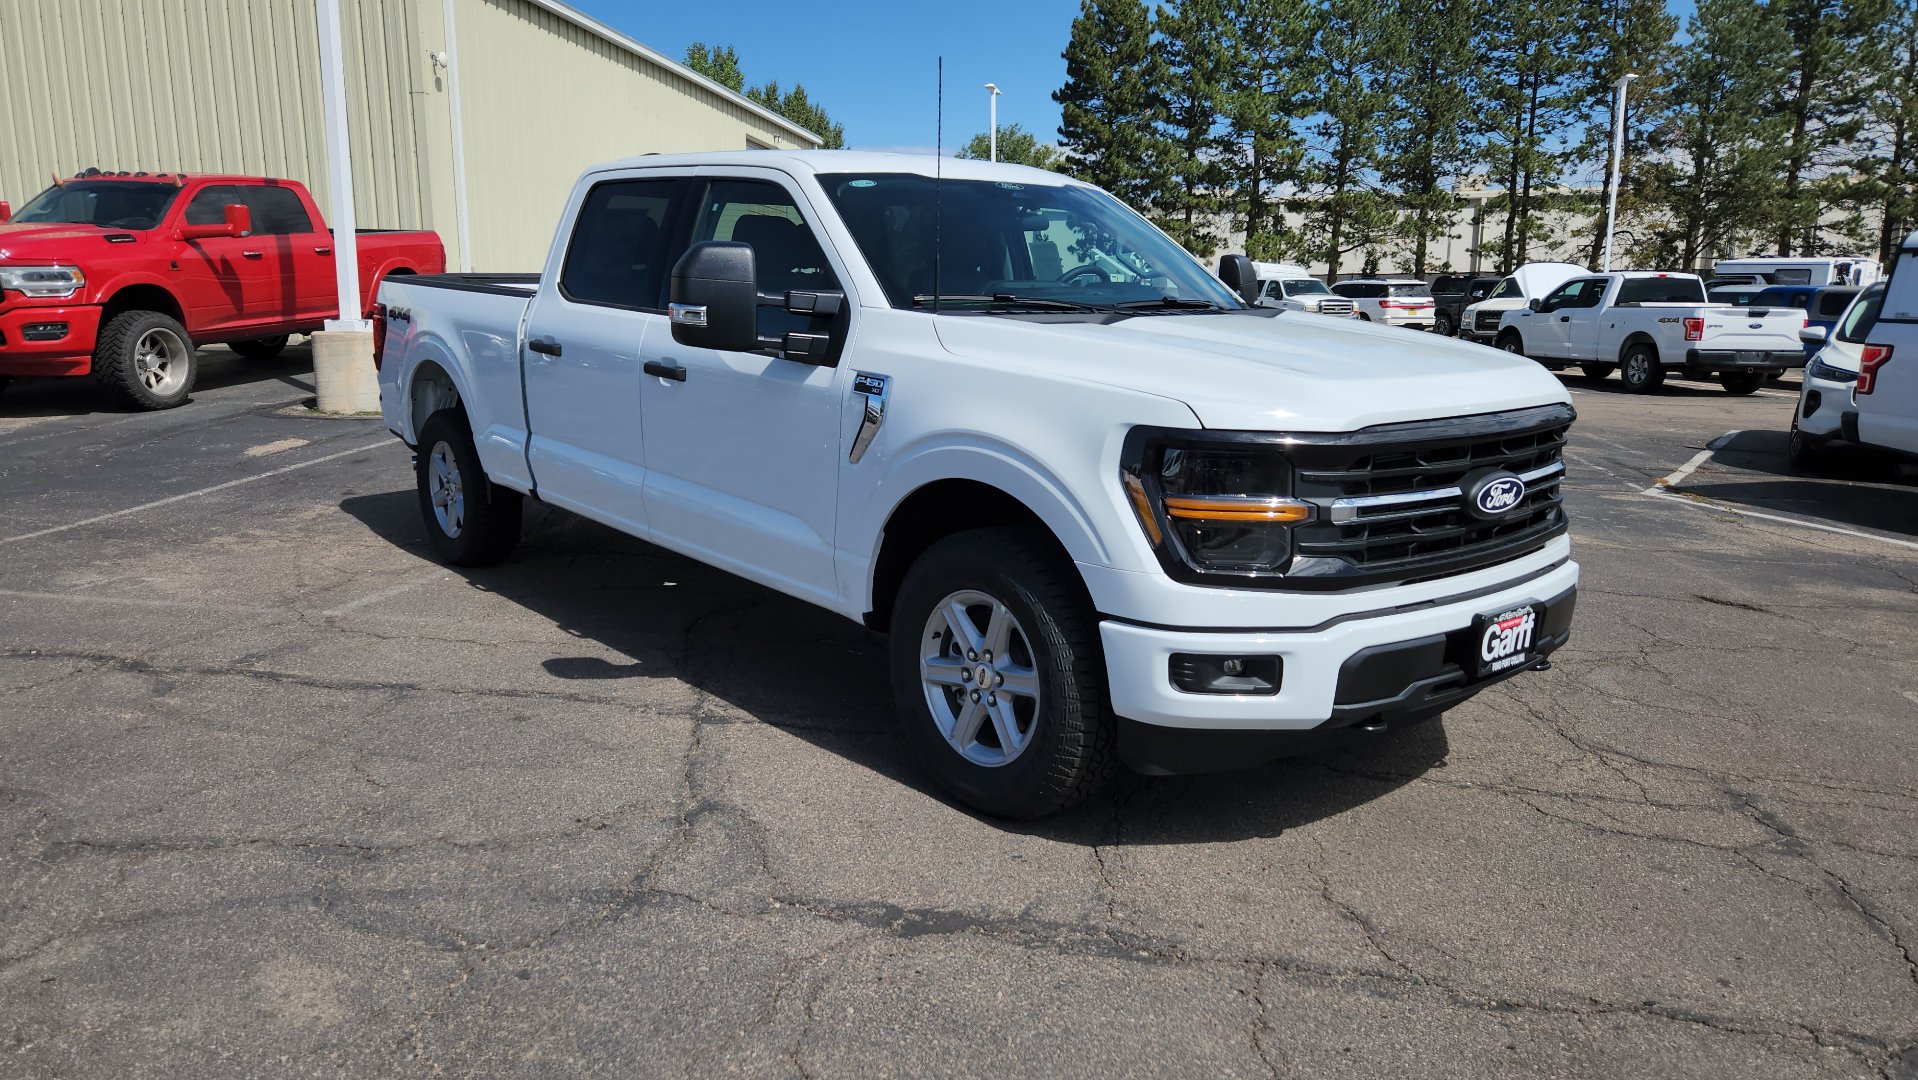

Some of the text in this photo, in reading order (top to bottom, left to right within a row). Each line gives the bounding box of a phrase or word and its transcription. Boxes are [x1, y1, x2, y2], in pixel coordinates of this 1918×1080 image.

[856, 376, 884, 388] F-150
[1486, 483, 1517, 508] Ford
[1482, 613, 1535, 661] Garff
